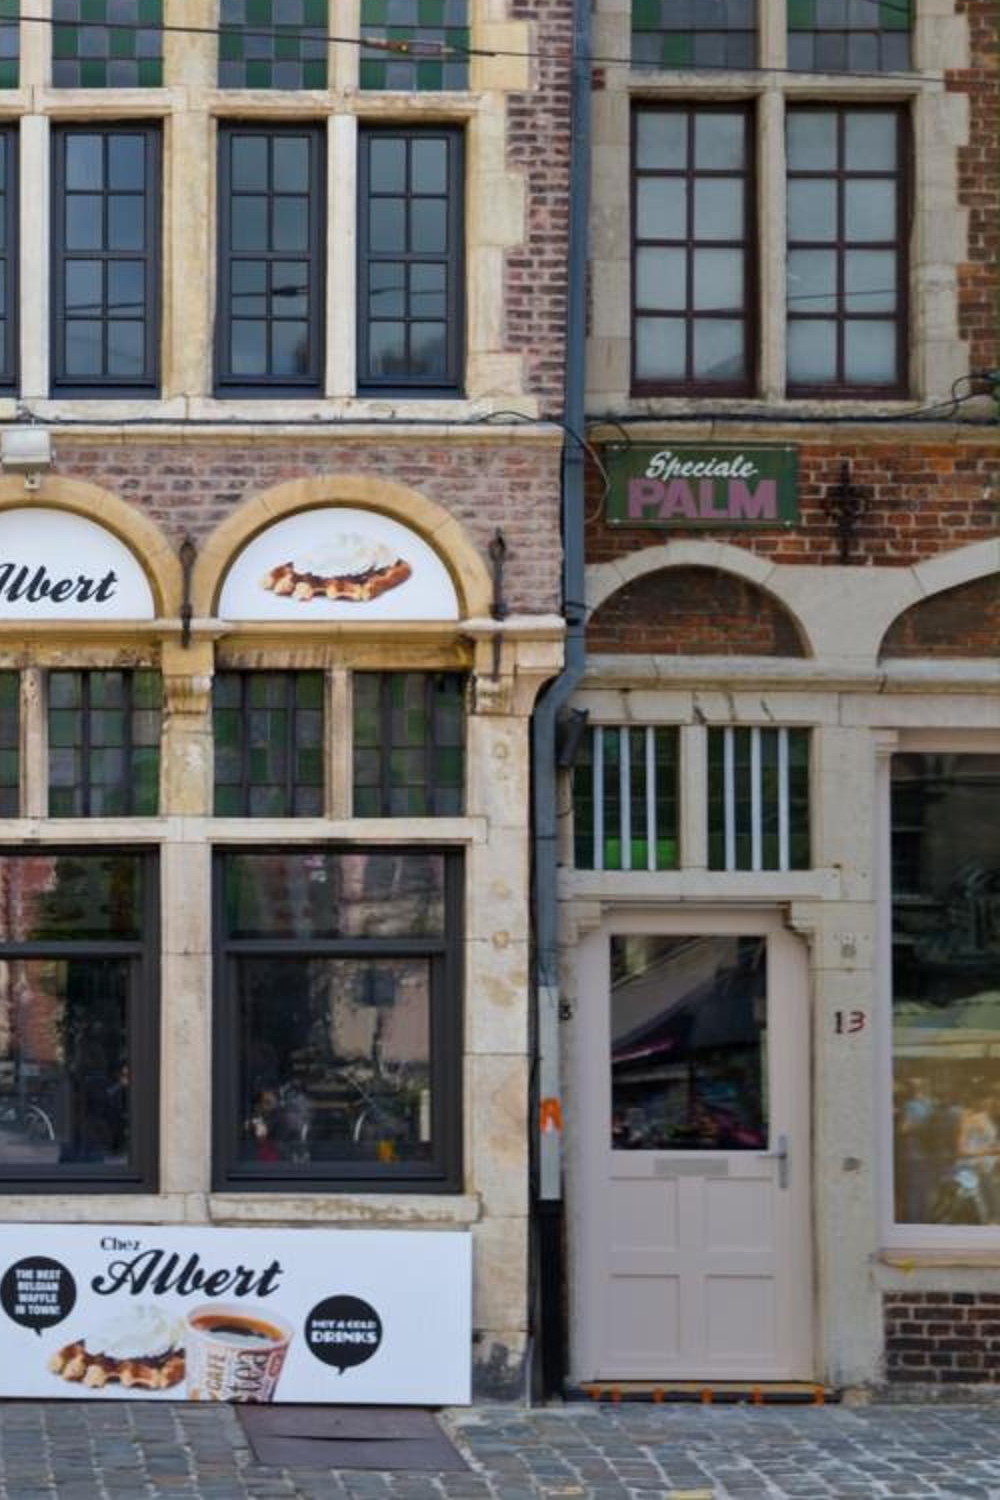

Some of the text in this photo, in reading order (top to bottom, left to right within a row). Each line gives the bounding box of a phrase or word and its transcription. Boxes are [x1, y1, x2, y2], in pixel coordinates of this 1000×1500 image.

[645, 451, 758, 481] Speciale
[628, 478, 777, 519] PALM
[835, 1011, 866, 1034] 13
[100, 1237, 140, 1250] Chez
[15, 1269, 34, 1279] THE
[91, 1249, 284, 1297] Albert
[18, 1293, 58, 1302] WAFFLE
[311, 1330, 377, 1344] DRINKS
